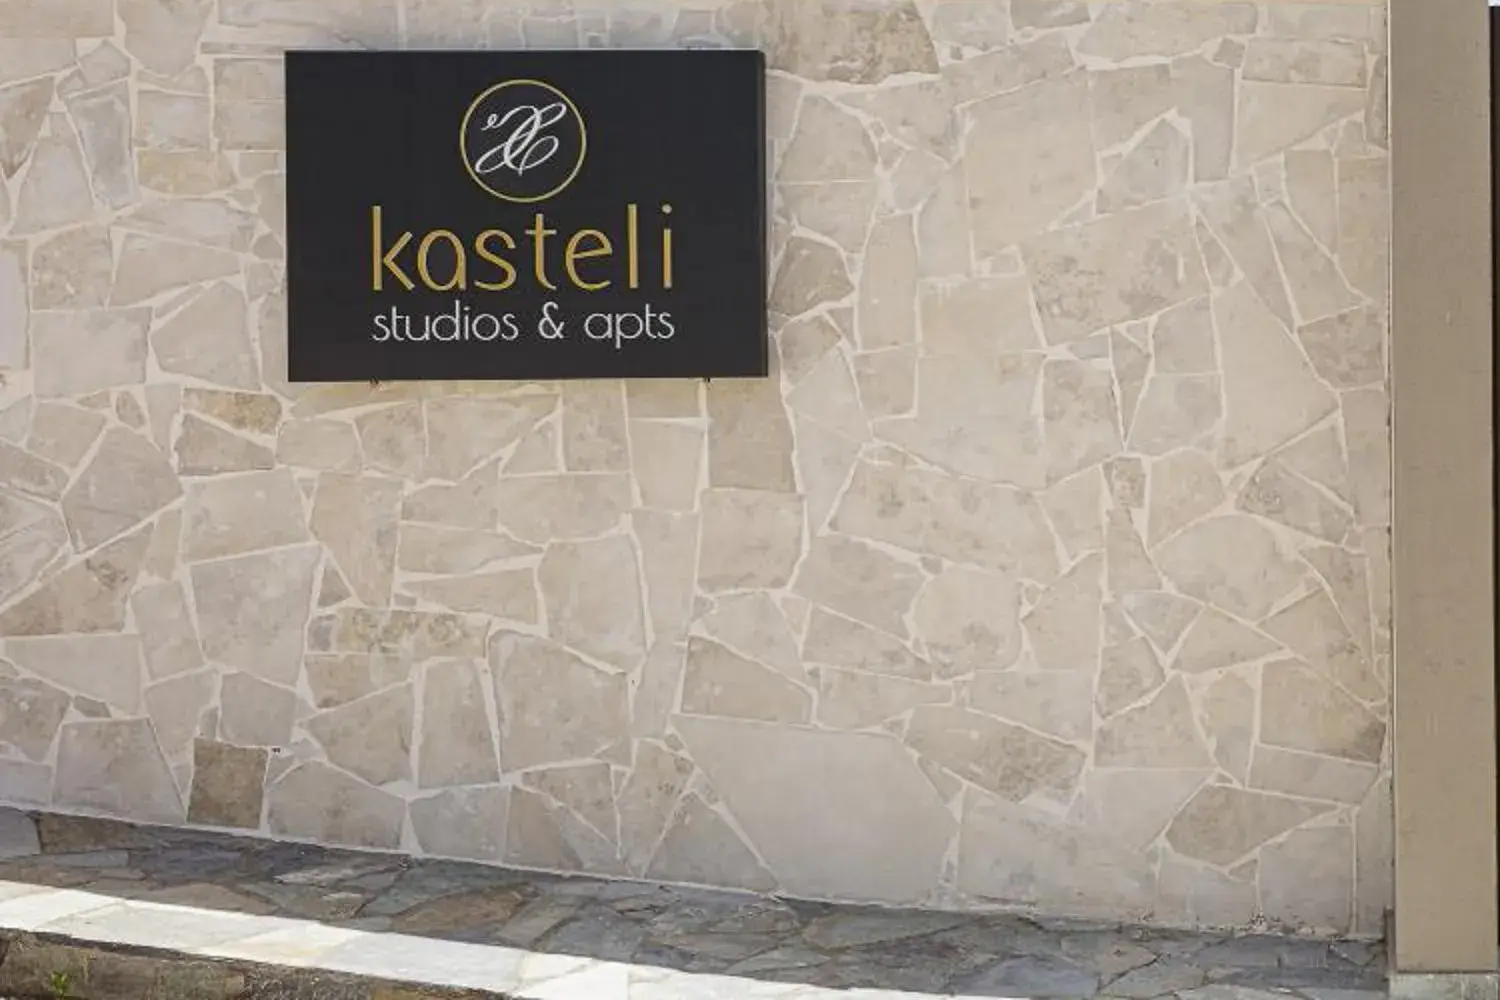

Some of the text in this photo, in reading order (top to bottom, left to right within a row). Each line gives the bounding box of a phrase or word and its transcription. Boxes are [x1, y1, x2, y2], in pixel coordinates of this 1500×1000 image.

[372, 203, 673, 291] kasteli
[371, 300, 675, 350] studios & apts
